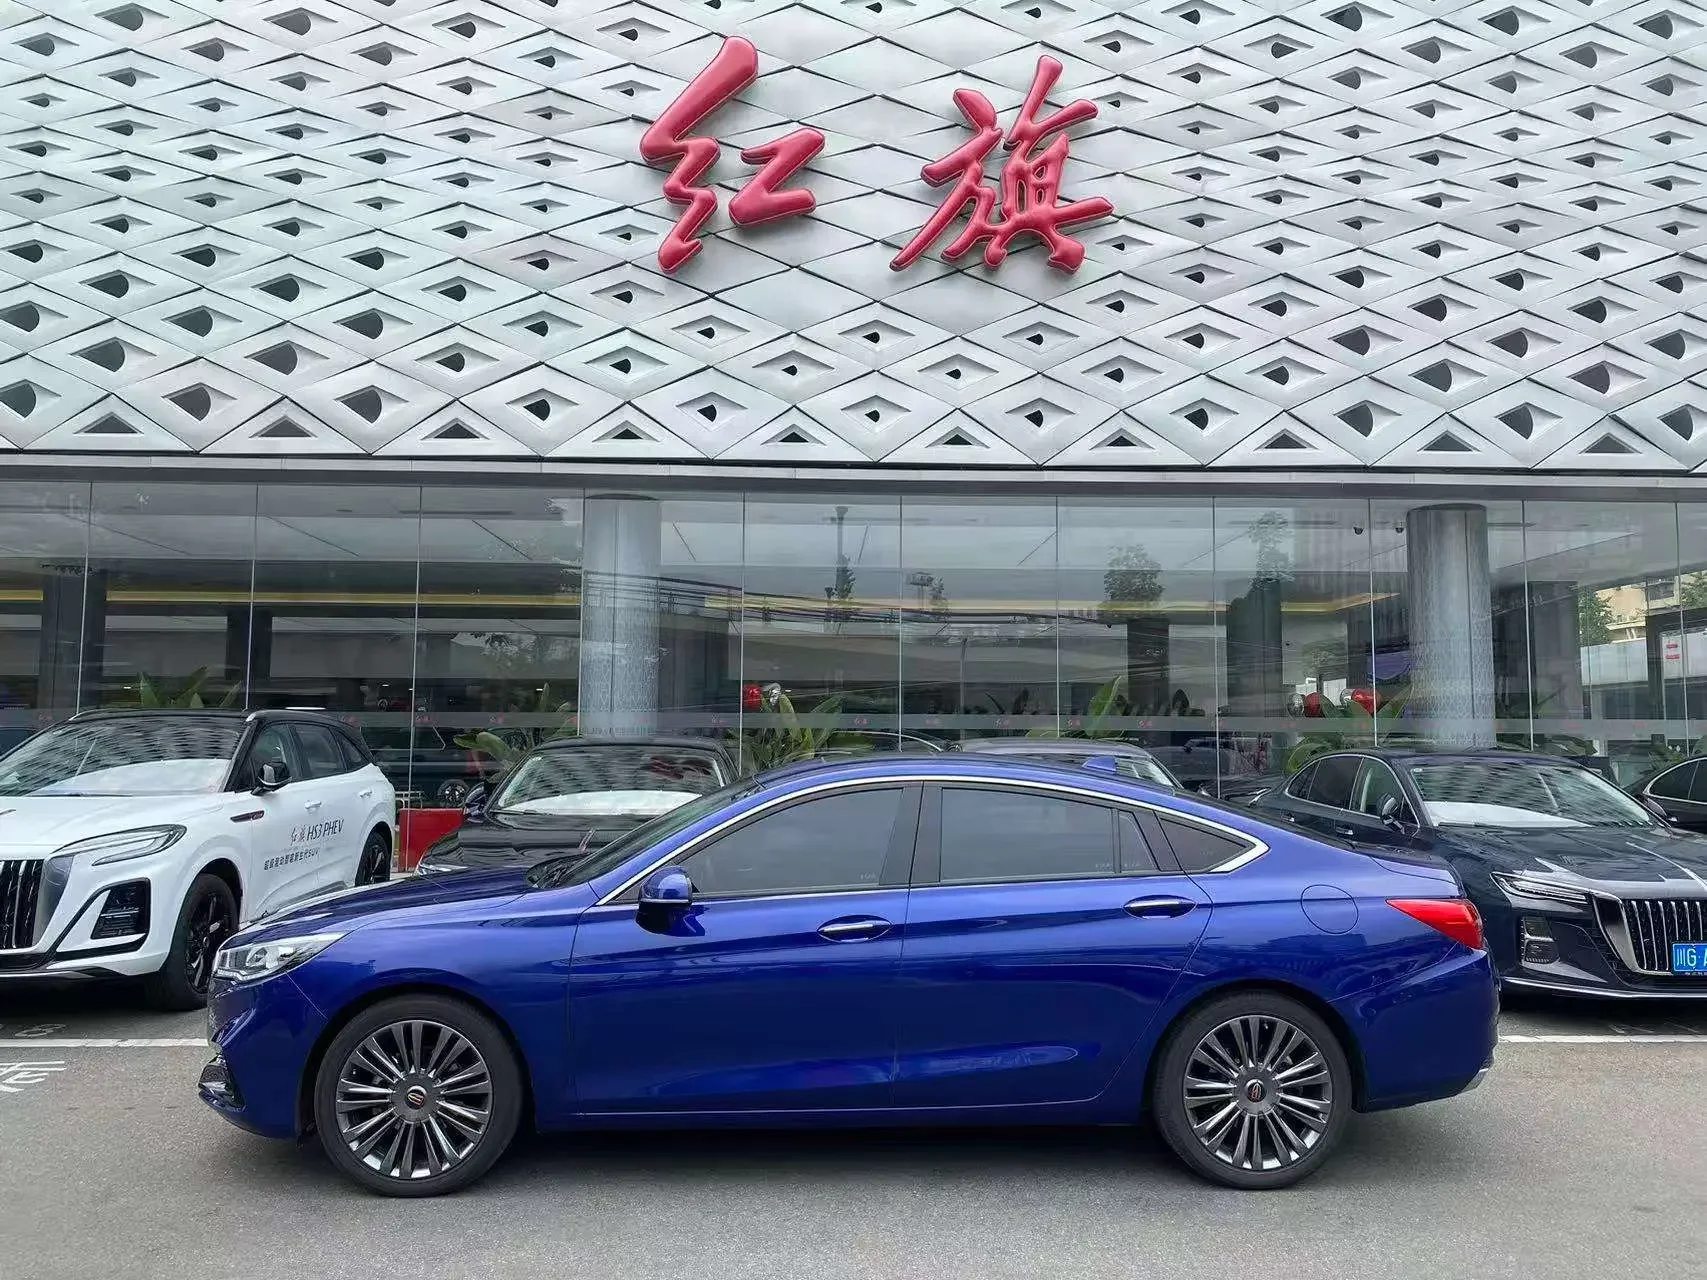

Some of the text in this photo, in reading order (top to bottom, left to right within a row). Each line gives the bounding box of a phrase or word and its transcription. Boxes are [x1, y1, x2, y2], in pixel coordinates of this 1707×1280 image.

[639, 36, 1115, 275] 红旗
[307, 823, 322, 841] HS3
[323, 819, 345, 837] PHEV
